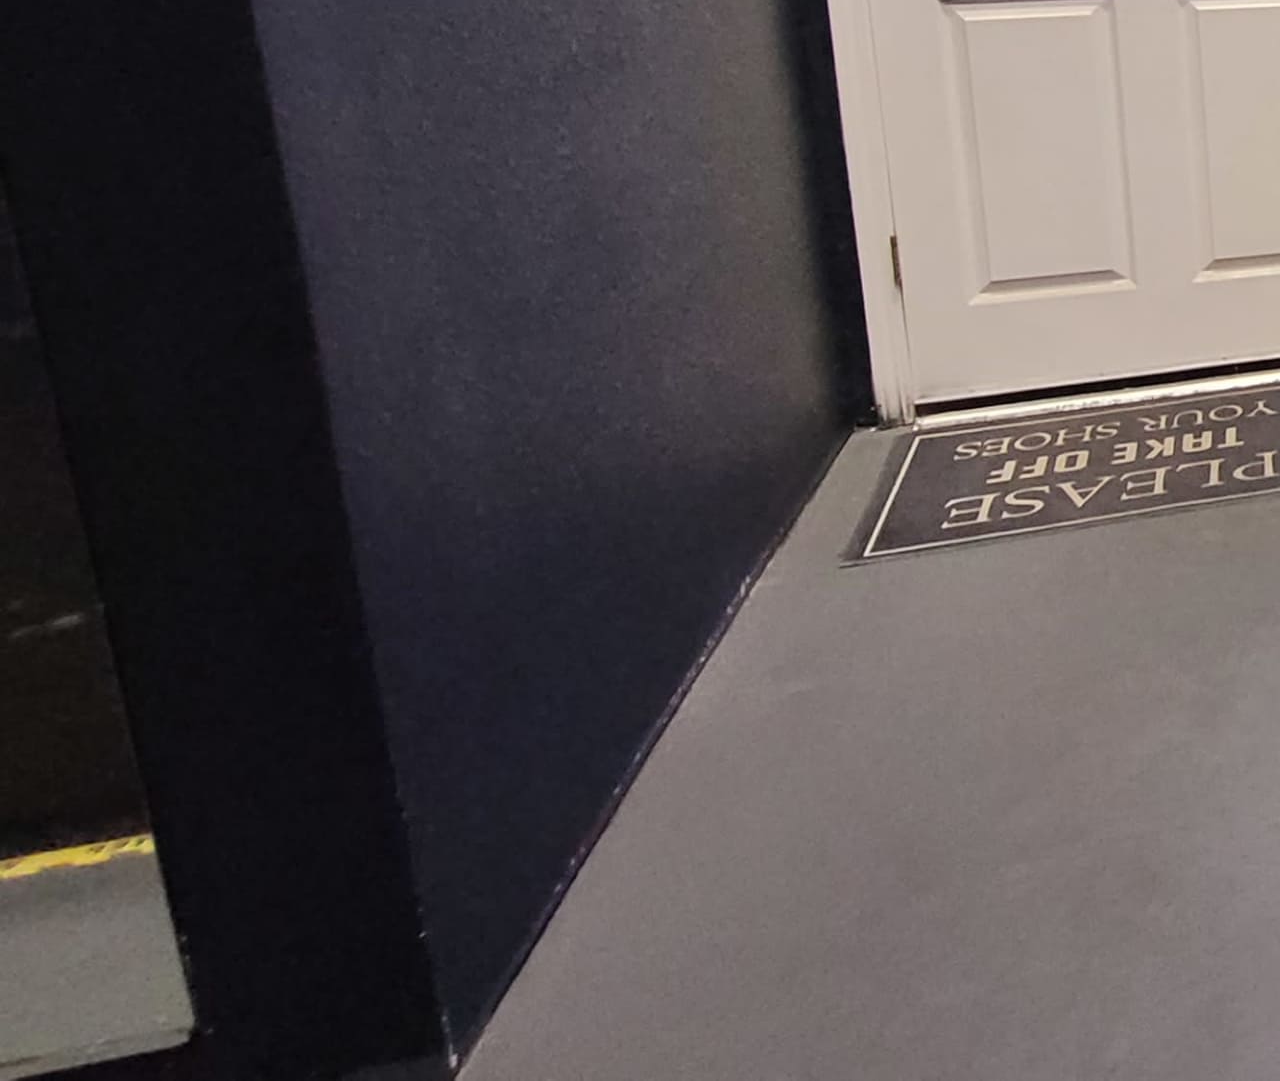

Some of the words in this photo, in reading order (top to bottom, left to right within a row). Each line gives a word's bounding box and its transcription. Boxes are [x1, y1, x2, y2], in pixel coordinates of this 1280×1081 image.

[1140, 399, 1278, 432] YOUR
[954, 421, 1121, 463] SHOES
[1112, 426, 1246, 465] TAKE
[986, 450, 1088, 485] OFF
[940, 450, 1280, 529] PLEASE
